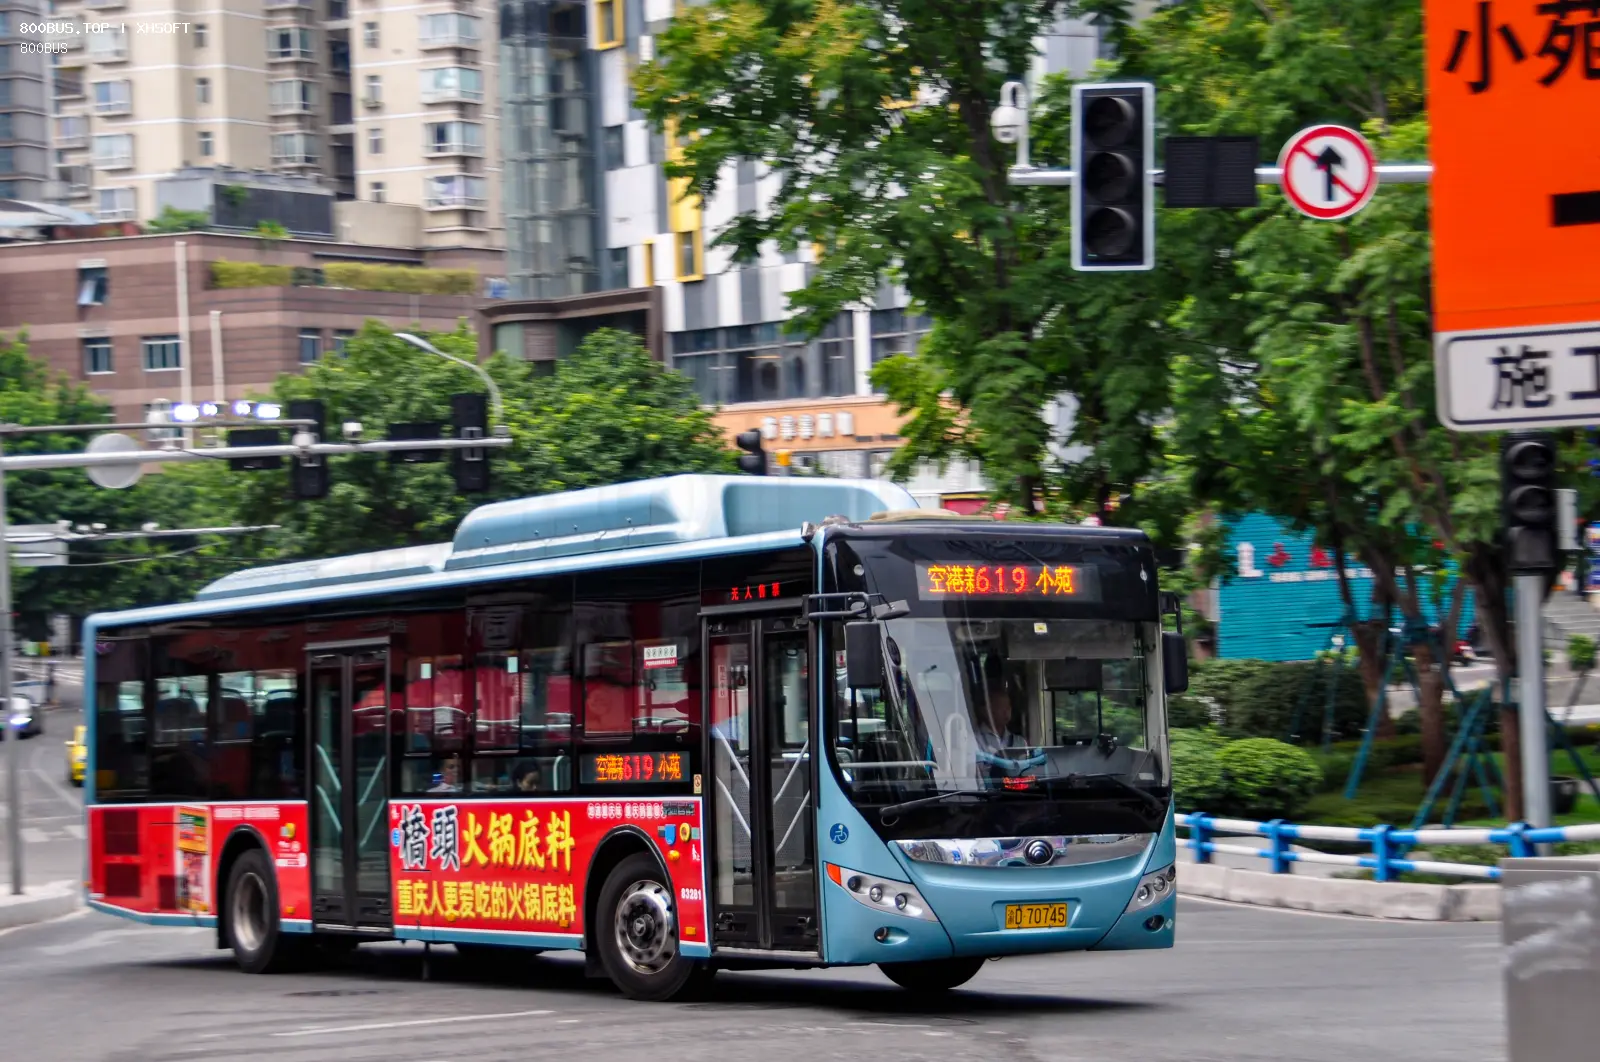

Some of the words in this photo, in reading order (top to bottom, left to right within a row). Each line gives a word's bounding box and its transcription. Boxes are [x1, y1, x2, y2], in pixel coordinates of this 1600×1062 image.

[1036, 565, 1073, 594] 小苑
[398, 879, 577, 922] 重庆人更爱吃的火锅底料
[681, 887, 702, 901] 83281
